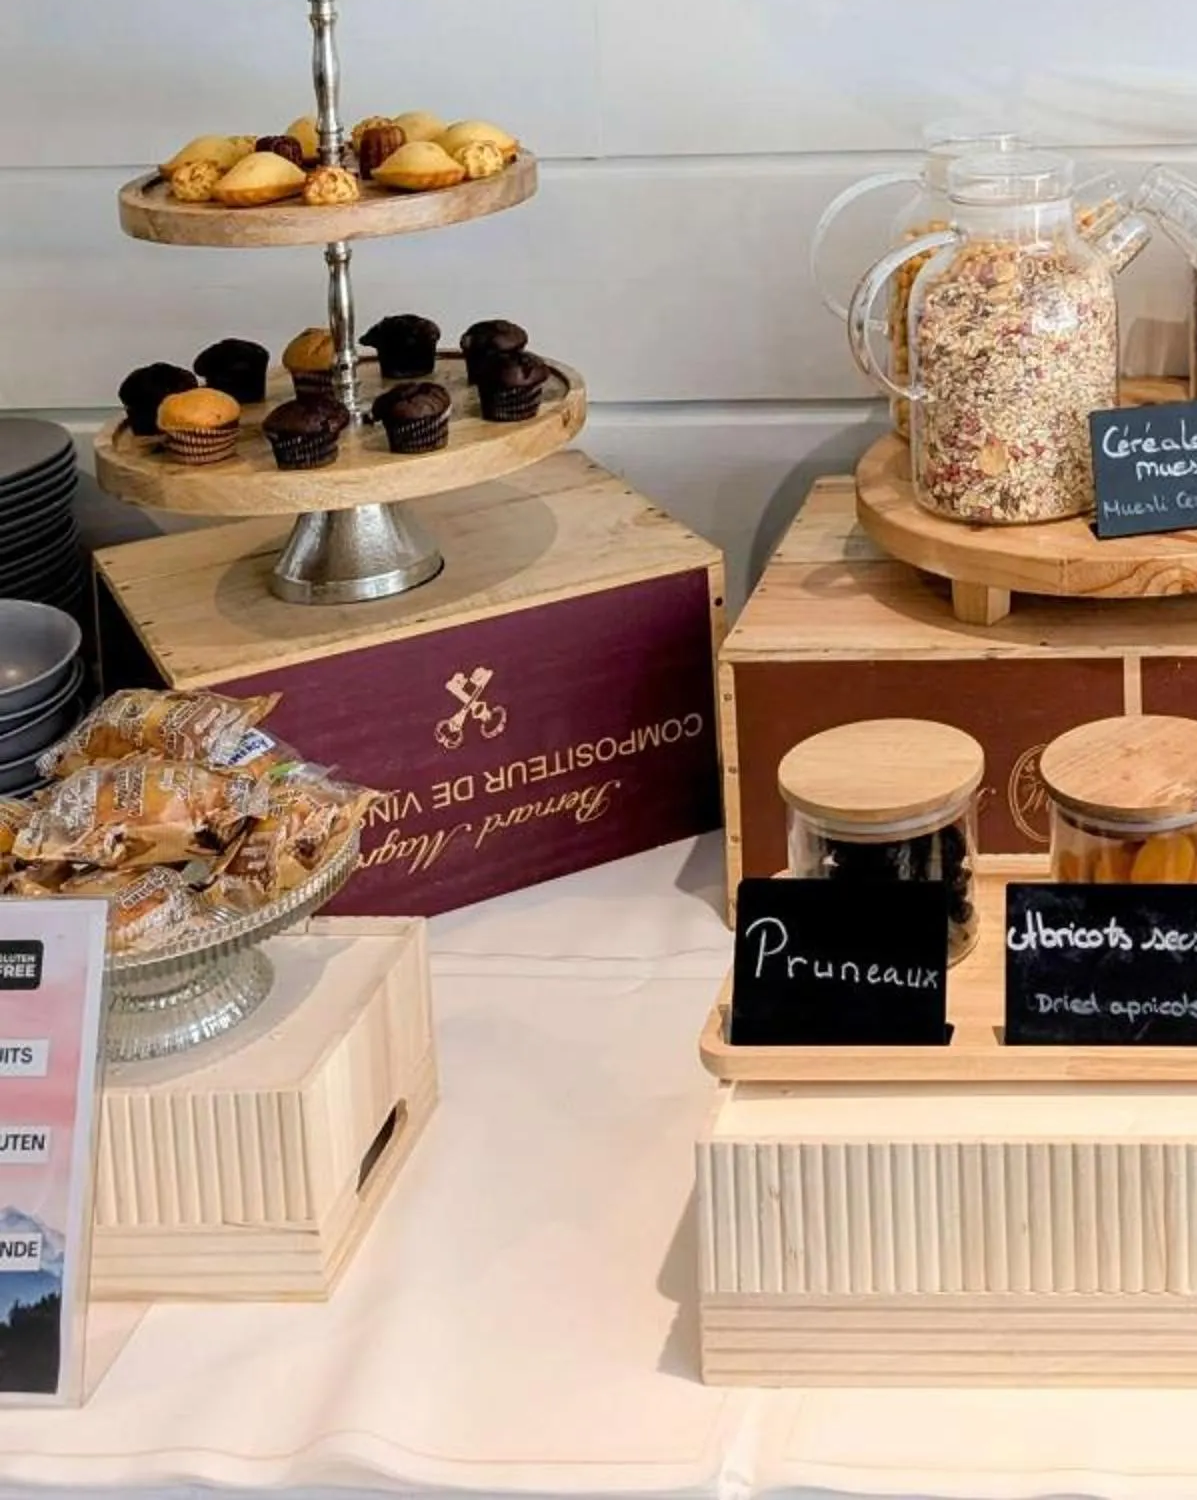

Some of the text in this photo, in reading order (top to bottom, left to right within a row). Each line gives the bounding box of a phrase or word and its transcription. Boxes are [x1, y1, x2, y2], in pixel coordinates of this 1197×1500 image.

[484, 712, 703, 794] COMPOSITEUR
[432, 775, 474, 809] DE
[474, 780, 621, 851] Bernard
[746, 917, 939, 989] Pruneaux
[1007, 909, 1133, 950] Abricots
[1035, 992, 1100, 1015] Dried
